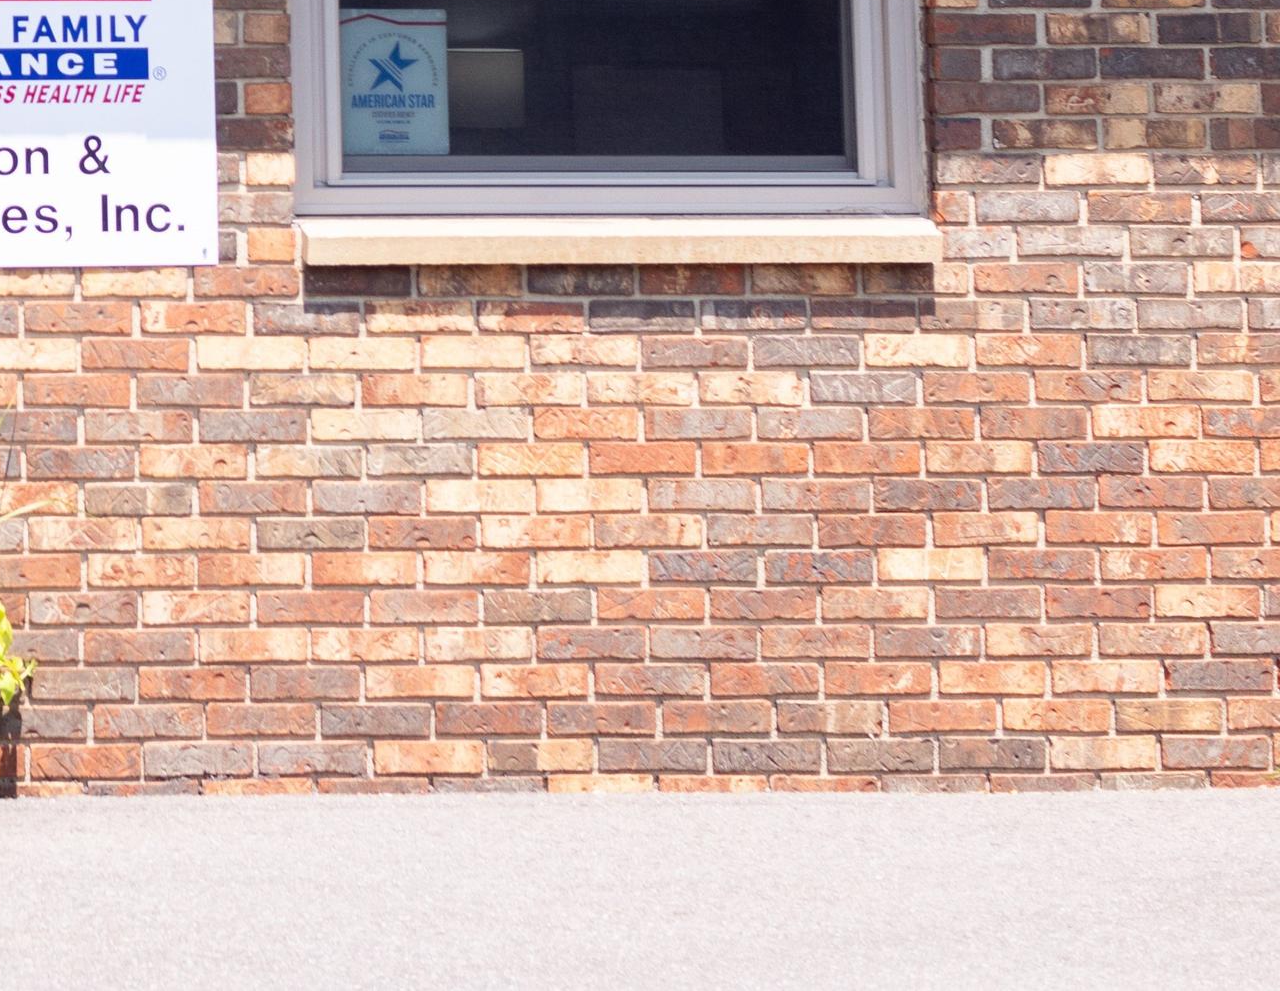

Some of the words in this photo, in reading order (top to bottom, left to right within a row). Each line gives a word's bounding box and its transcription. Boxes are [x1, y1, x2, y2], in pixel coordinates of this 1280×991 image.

[13, 16, 146, 42] FAMILY
[24, 85, 97, 103] HEALTH
[103, 85, 144, 103] LIFE
[351, 93, 406, 109] AMERICAN
[408, 93, 435, 109] STAR
[80, 136, 111, 174] &
[102, 195, 184, 232] Inc.
